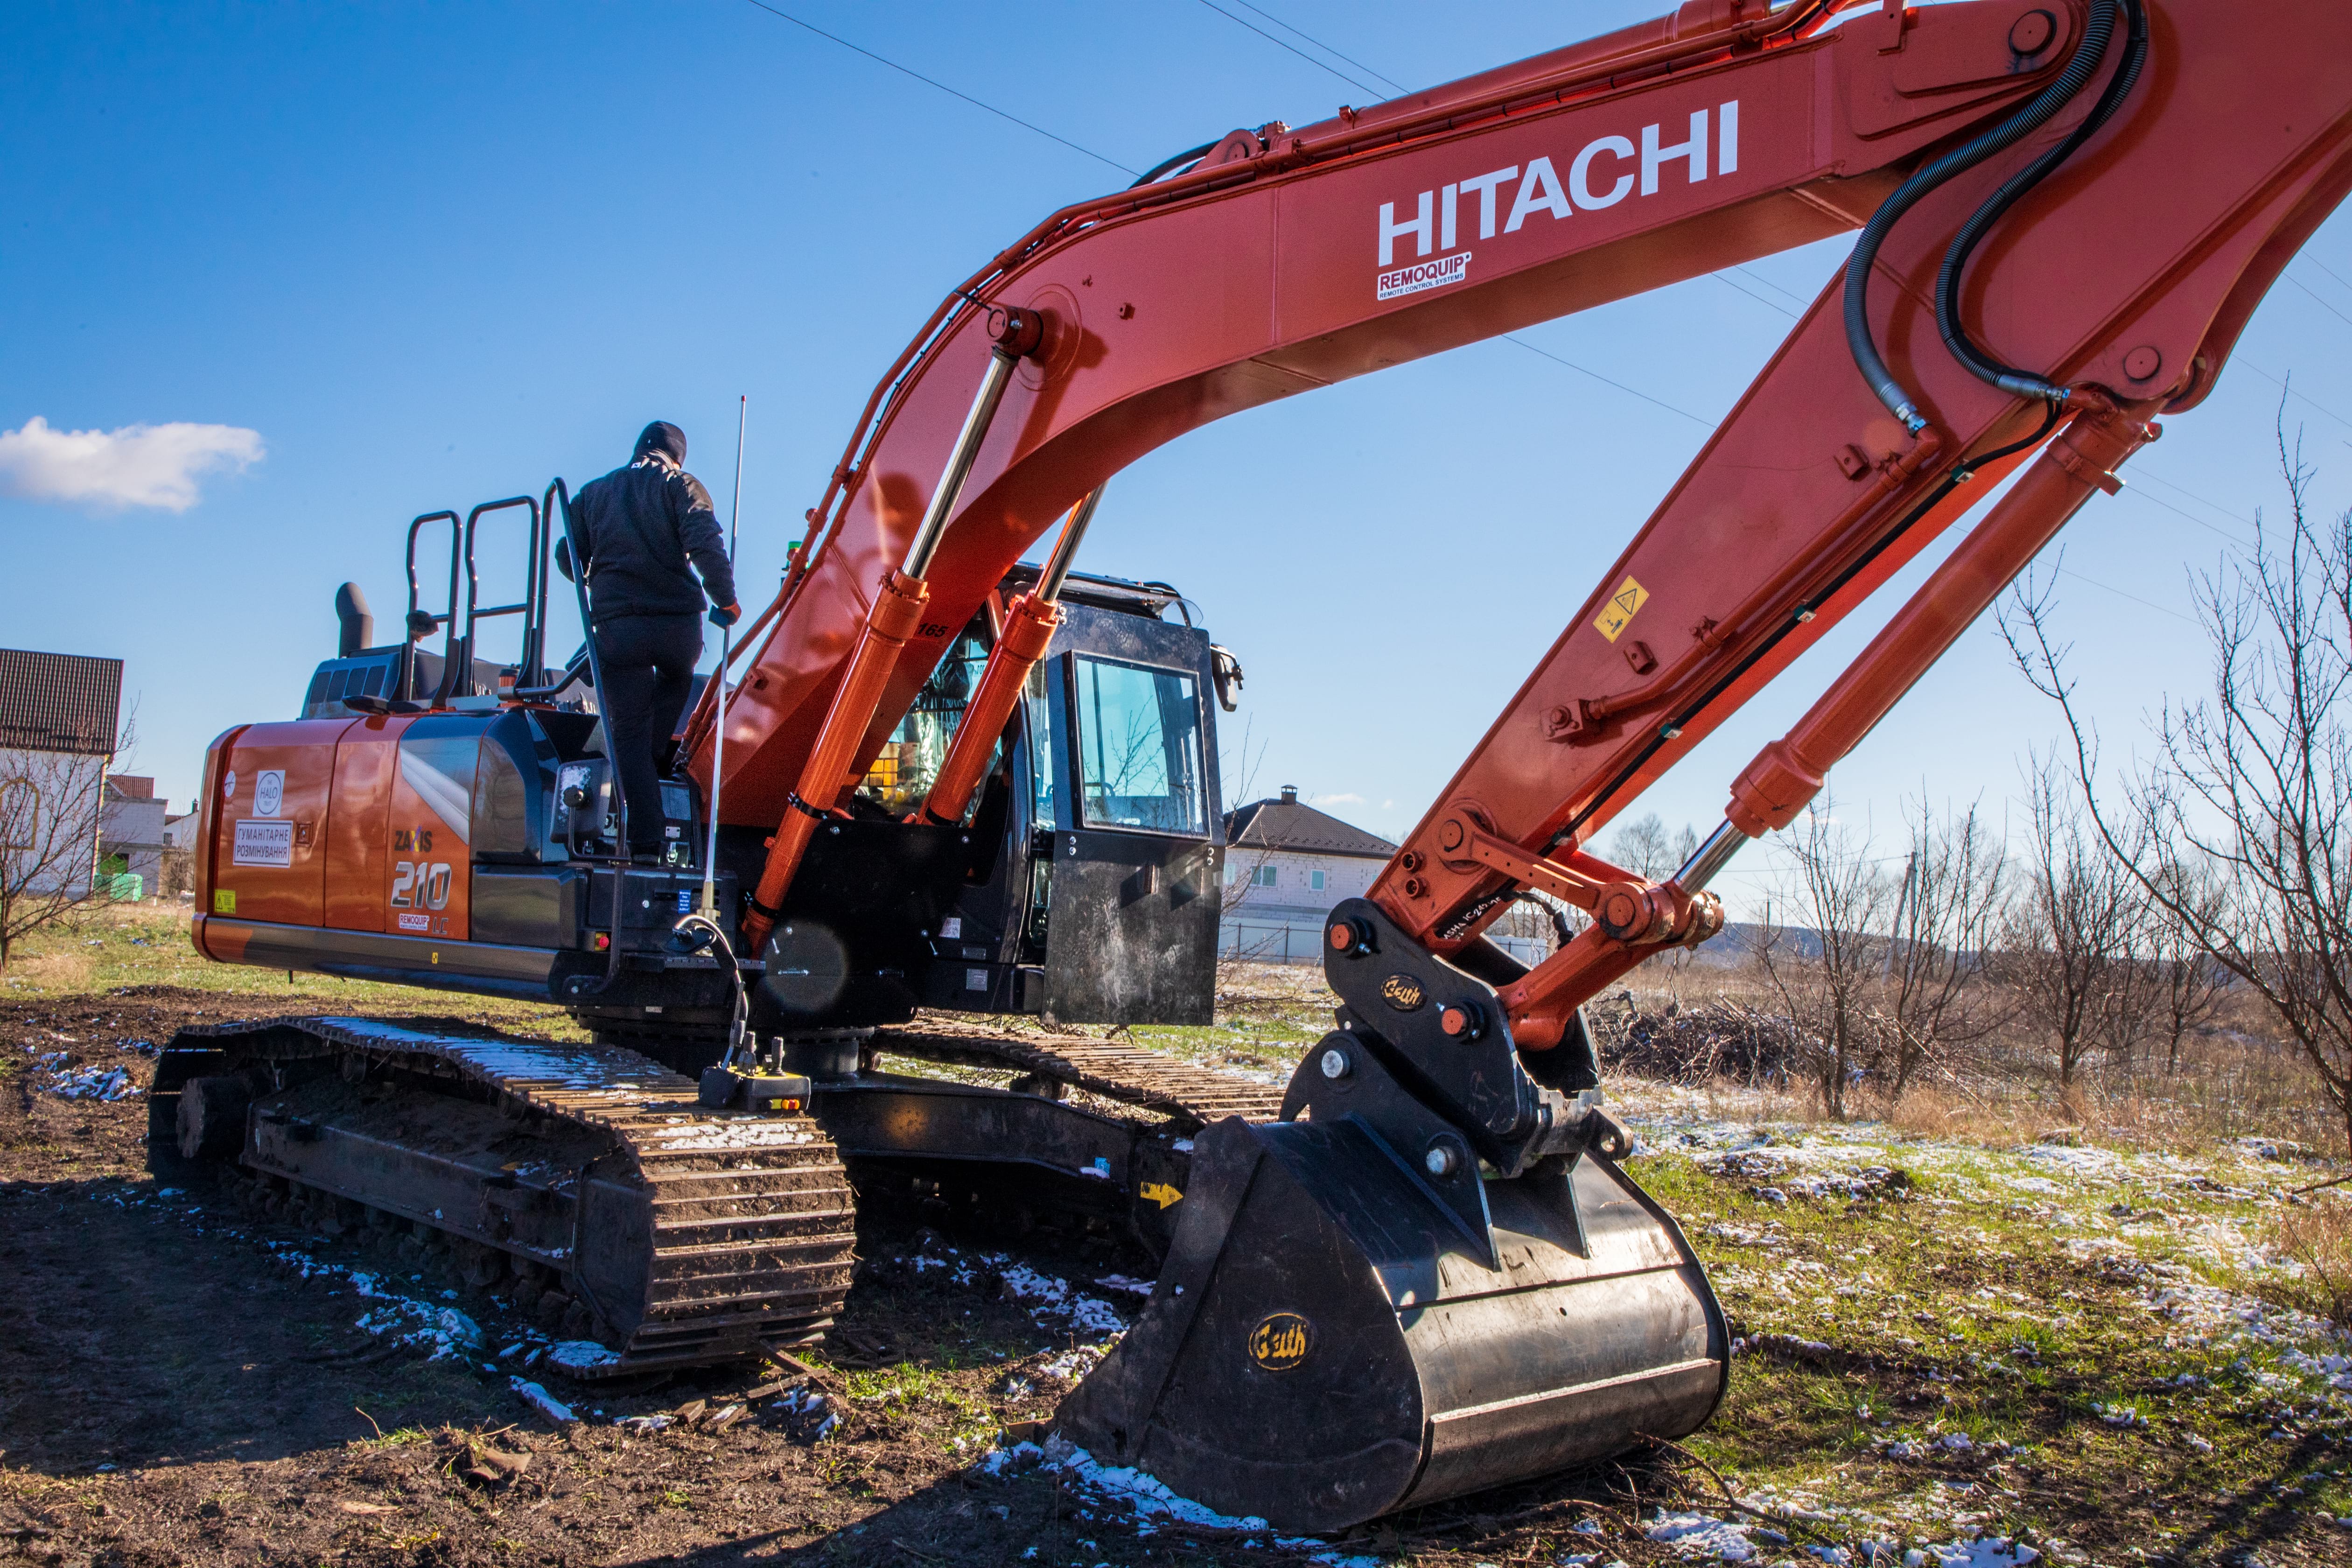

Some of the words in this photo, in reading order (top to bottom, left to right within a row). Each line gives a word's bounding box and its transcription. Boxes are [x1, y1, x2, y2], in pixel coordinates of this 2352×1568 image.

[1379, 100, 1738, 267] HITACHI
[1380, 256, 1464, 291] REMOQUIP
[1379, 288, 1404, 299] REMOTE
[1406, 282, 1434, 292] CONTROL
[1435, 273, 1463, 285] SYSTEMS
[918, 623, 949, 637] 165
[260, 787, 278, 799] HALO
[238, 828, 288, 841] ГУМАНІТАРНЕ
[394, 826, 433, 852] ZAXIS
[237, 845, 287, 859] РОЗМІНУВАННЯ
[391, 861, 452, 910] 210
[400, 915, 427, 925] REMOQUIP
[432, 917, 448, 935] LC
